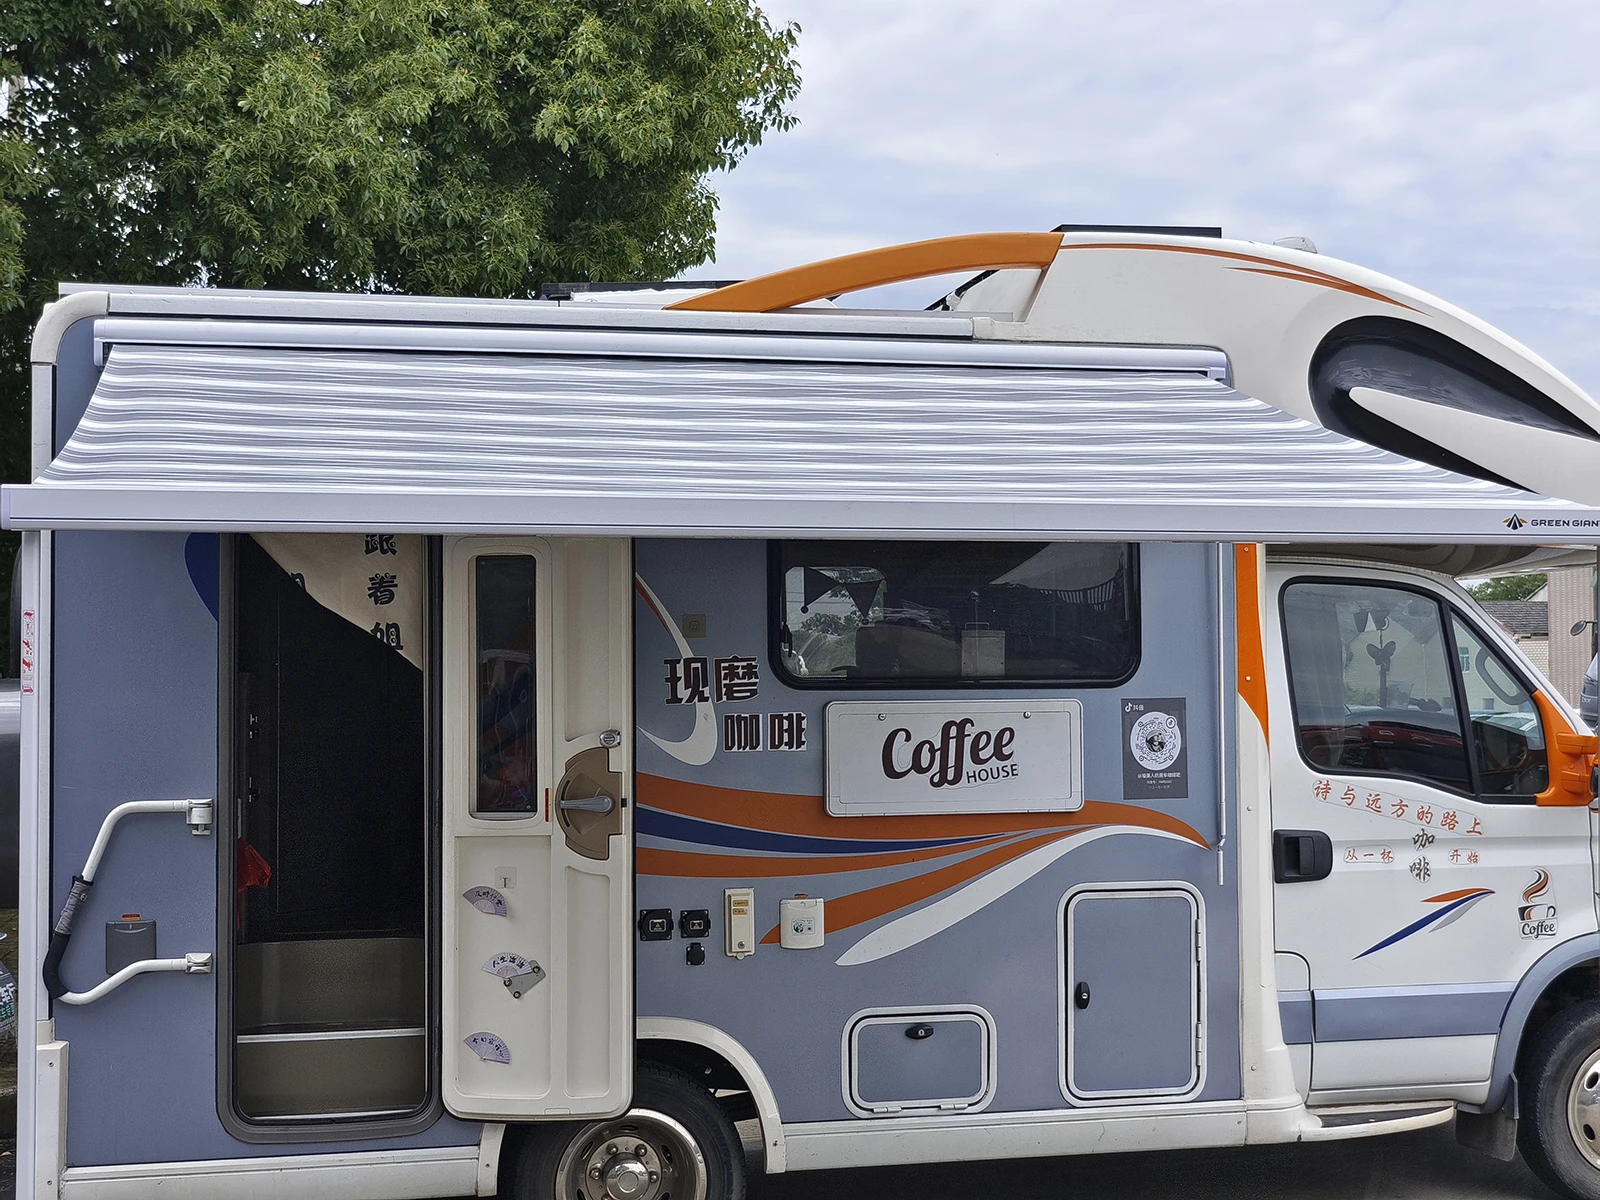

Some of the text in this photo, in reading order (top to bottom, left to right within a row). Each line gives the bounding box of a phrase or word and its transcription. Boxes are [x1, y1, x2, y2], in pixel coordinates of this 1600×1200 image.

[1531, 519, 1570, 527] GREEN
[663, 655, 760, 705] 现磨
[723, 712, 808, 752] 咖啡
[881, 717, 1016, 788] Coffee
[965, 763, 1019, 784] HOUSE
[1313, 779, 1484, 836] 诗与远方的路上
[1345, 848, 1395, 862] 从一杯
[1408, 828, 1436, 882] 咖啡
[1449, 848, 1480, 864] 开始
[1521, 920, 1556, 939] Coffee
